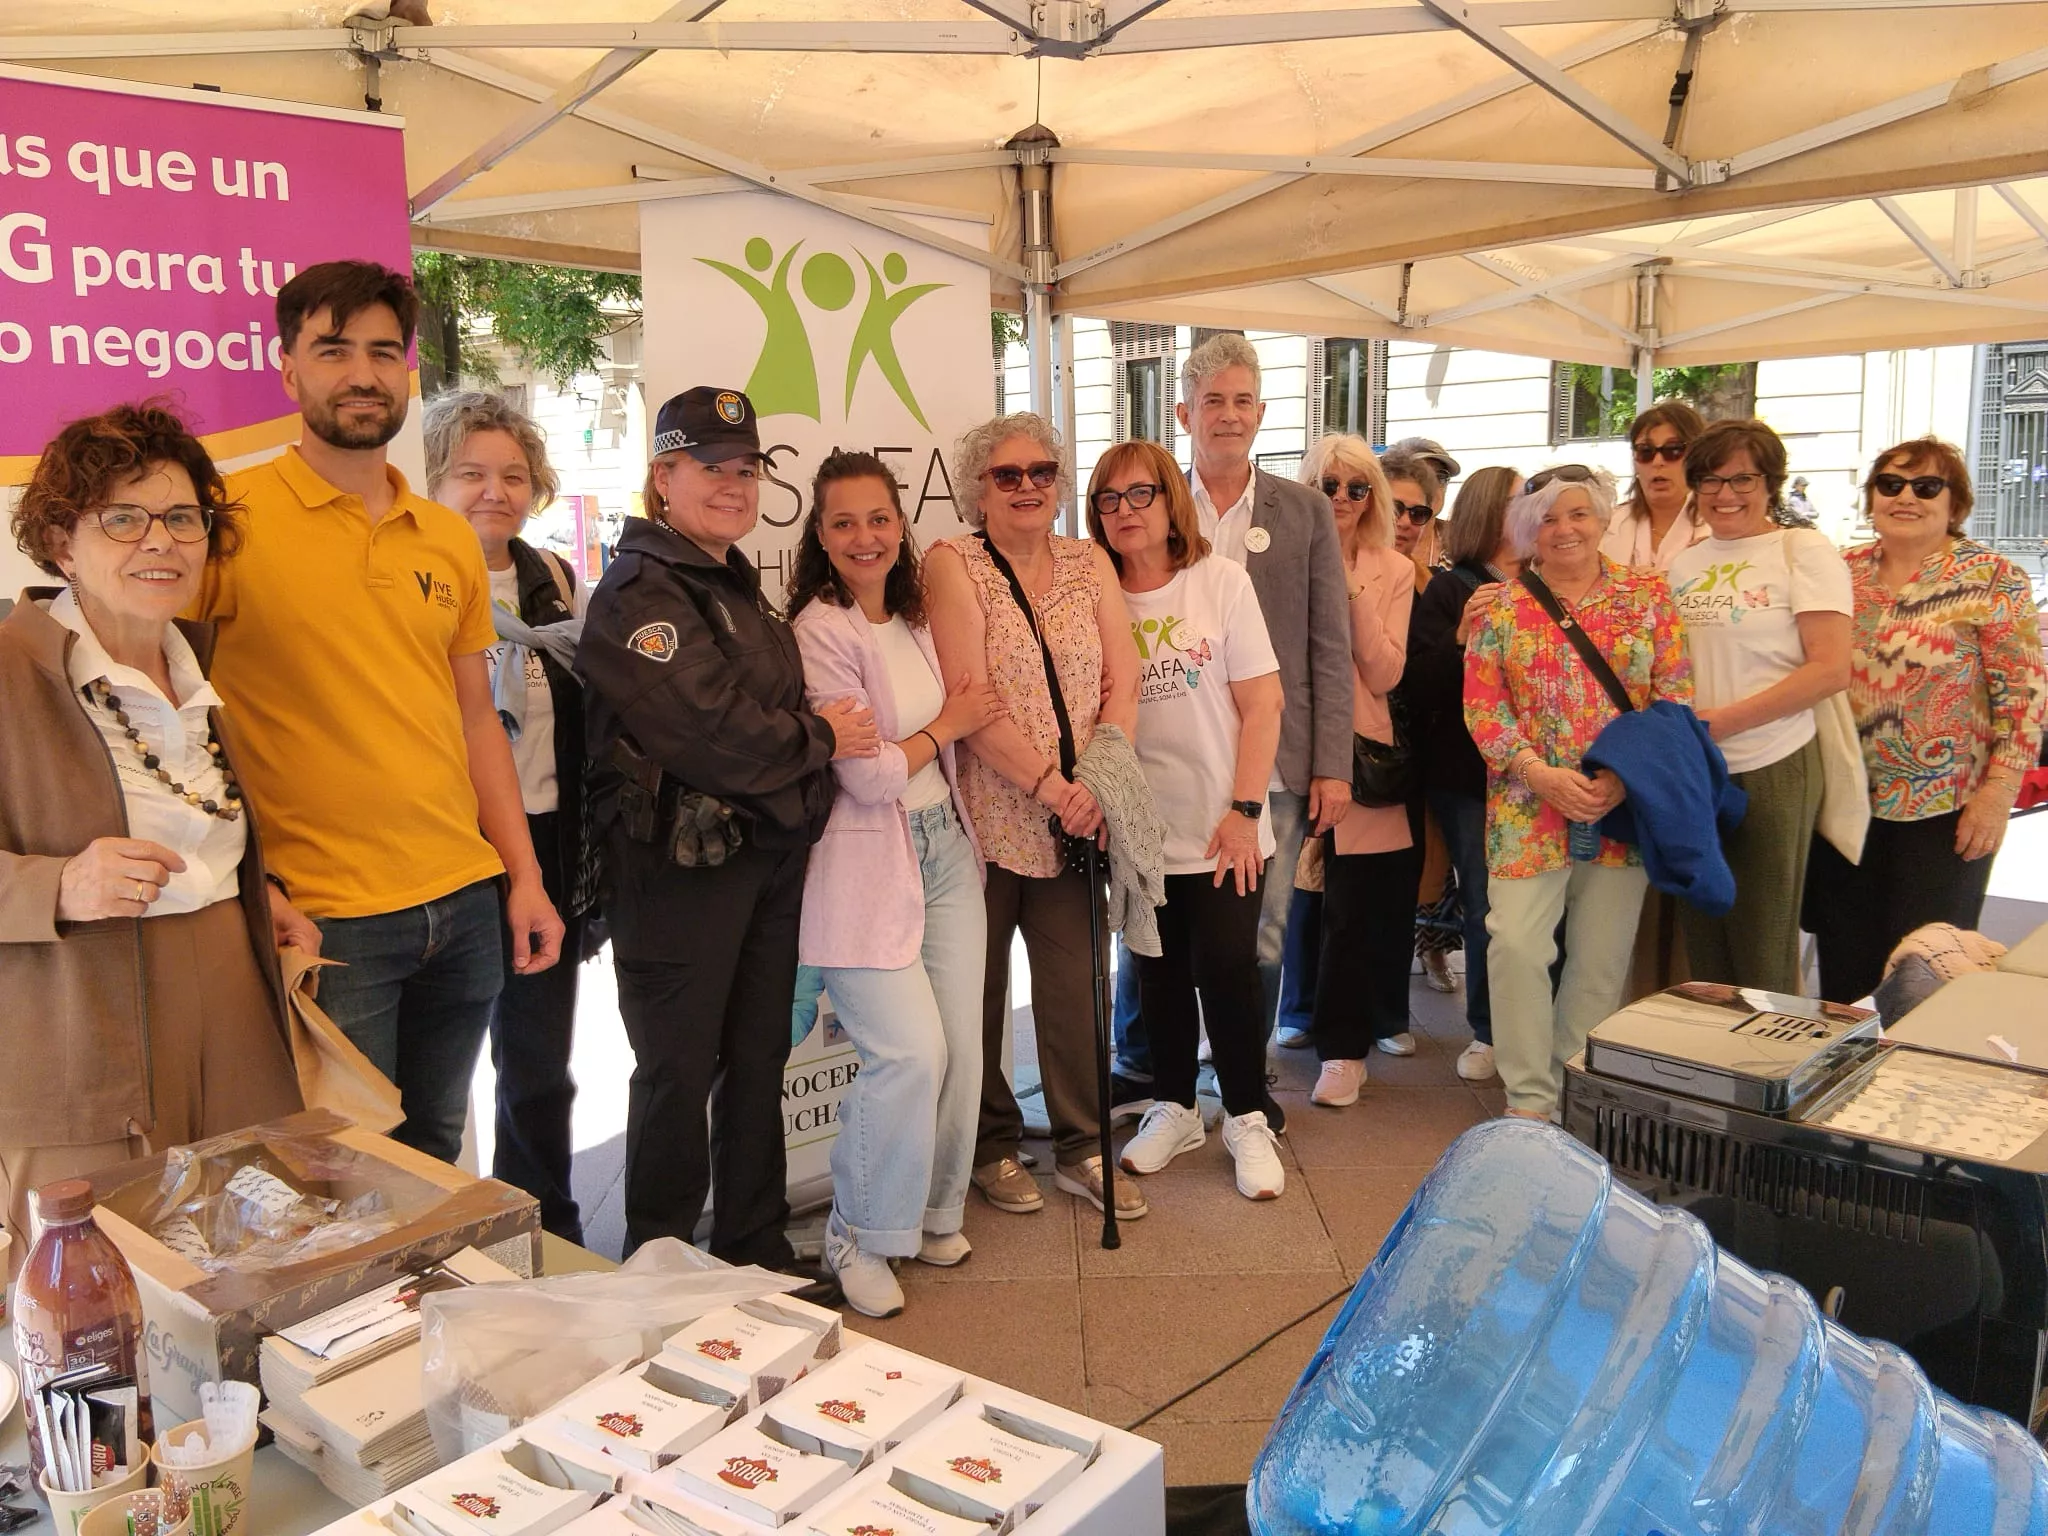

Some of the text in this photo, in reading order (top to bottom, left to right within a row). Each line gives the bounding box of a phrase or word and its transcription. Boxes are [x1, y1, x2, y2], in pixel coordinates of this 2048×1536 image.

[67, 141, 196, 195] que
[212, 157, 290, 201] un
[72, 244, 227, 297] para
[239, 247, 297, 298] tu
[1677, 595, 1734, 609] ASAFA
[1683, 611, 1720, 621] HUESCA
[635, 626, 663, 641] HUESCA
[1140, 681, 1179, 697] UESCA
[781, 1063, 860, 1102] NOCER
[86, 1326, 115, 1344] eliges
[706, 1342, 731, 1358] ORUS
[829, 1404, 856, 1419] ORUS
[606, 1417, 634, 1433] ORUS
[92, 1443, 108, 1477] ORUS
[728, 1459, 771, 1484] ORUS
[959, 1461, 991, 1479] ORUS
[226, 1480, 243, 1500] TREE
[462, 1498, 490, 1514] ORUS
